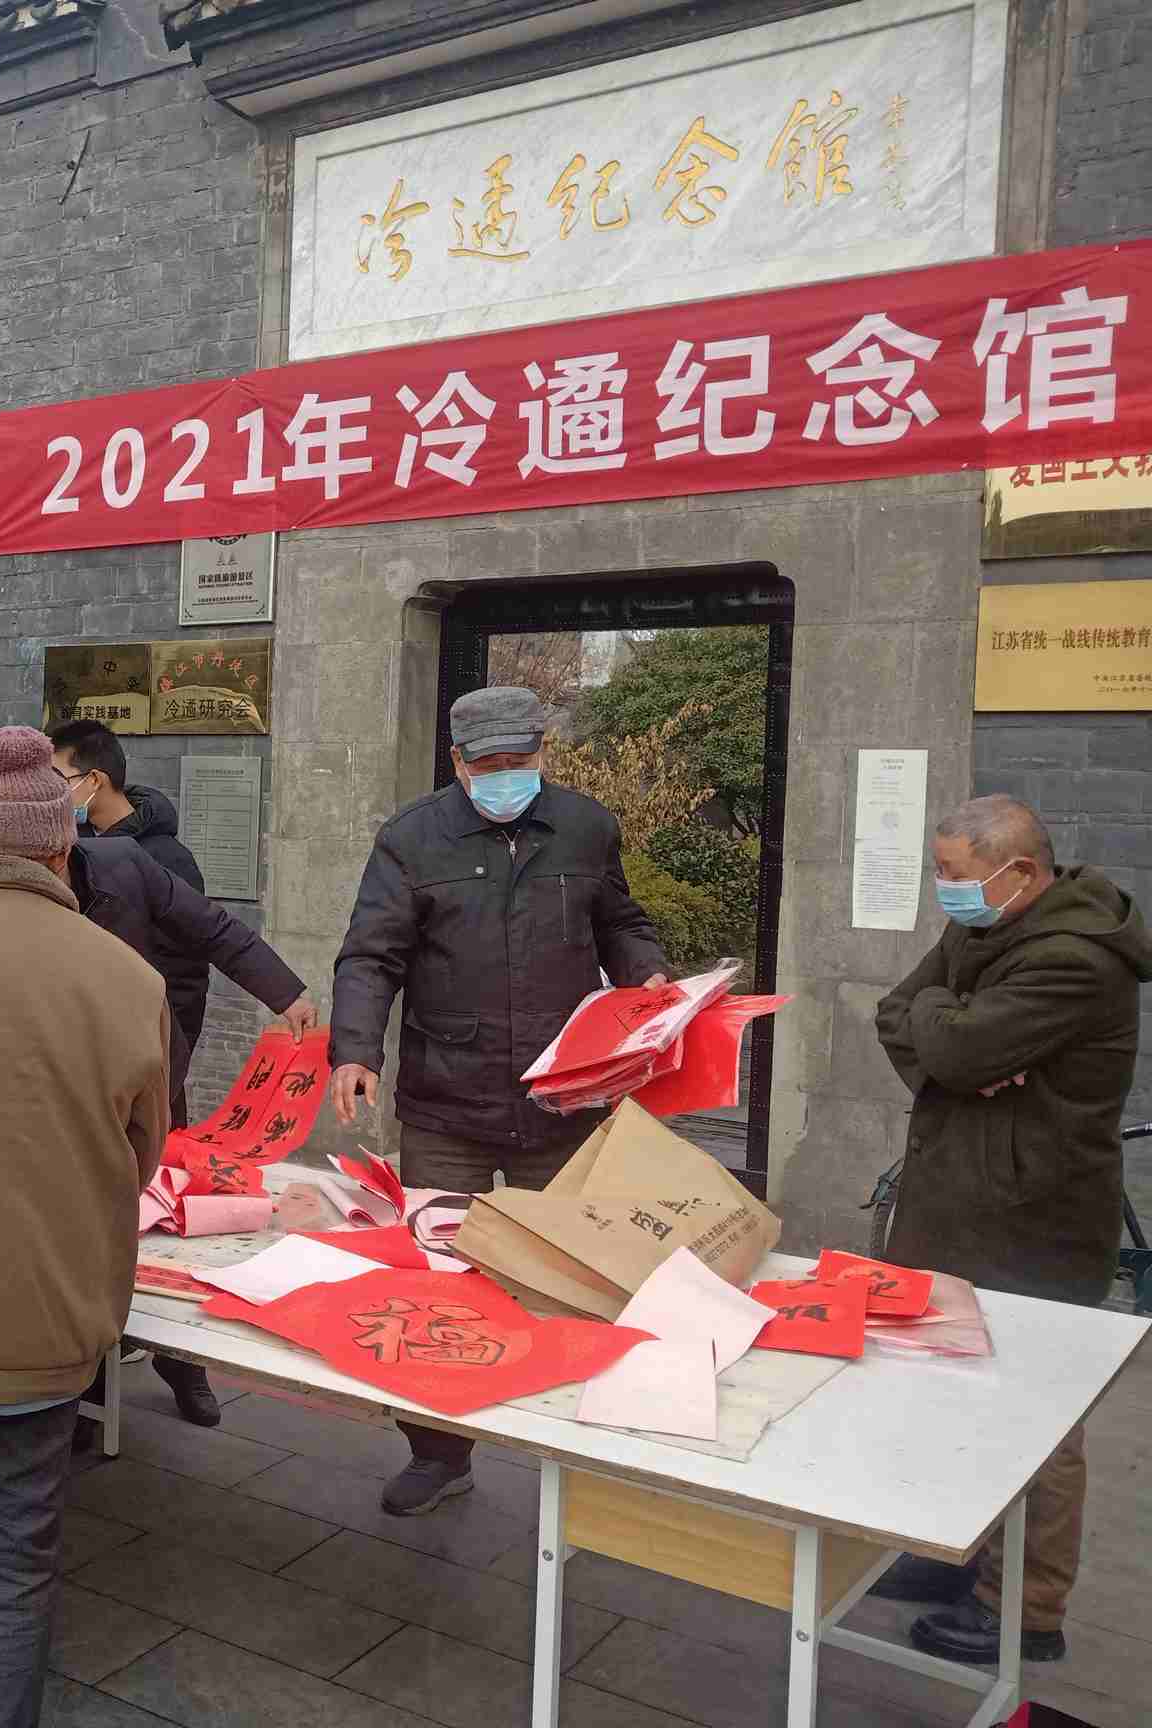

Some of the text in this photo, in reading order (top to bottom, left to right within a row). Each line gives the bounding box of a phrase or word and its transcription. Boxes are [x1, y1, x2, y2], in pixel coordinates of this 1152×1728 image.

[41, 286, 1129, 515] 2021年冷遹纪念馆
[991, 627, 1152, 651] 江苏省统一战线传统教育
[348, 1296, 506, 1366] 福
